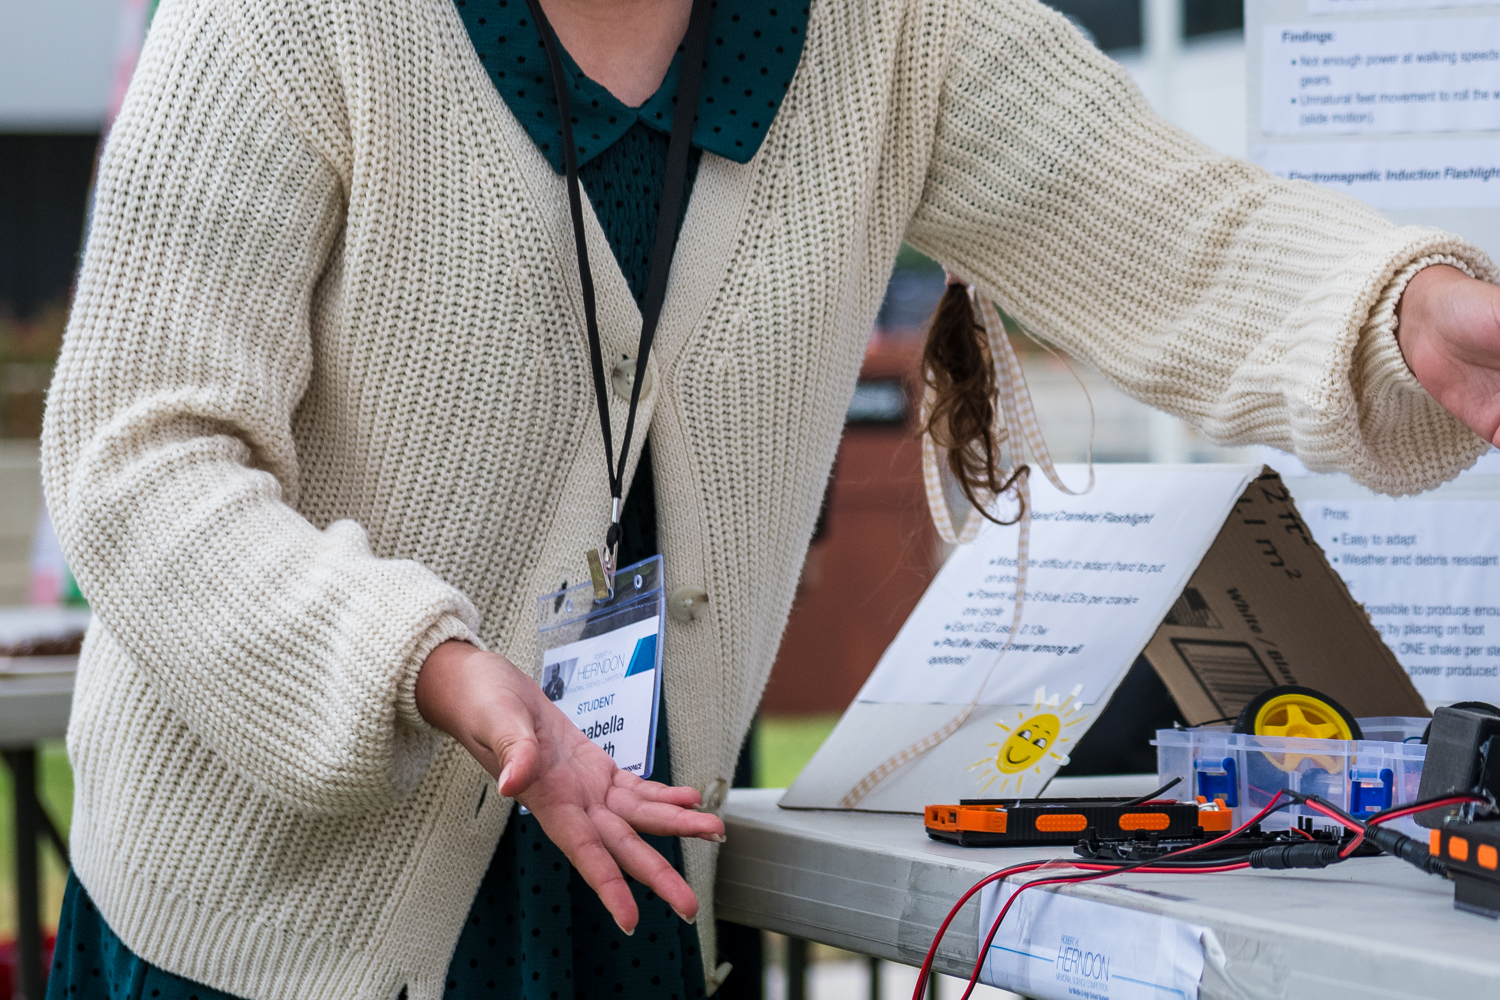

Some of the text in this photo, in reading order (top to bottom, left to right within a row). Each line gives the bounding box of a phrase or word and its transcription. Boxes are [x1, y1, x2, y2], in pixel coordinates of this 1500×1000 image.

[1342, 533, 1417, 548] Easy to adapt
[1342, 553, 1499, 567] Weather and debris resistant
[577, 693, 615, 715] STUDENT
[581, 714, 624, 740] abella
[1056, 946, 1110, 981] HERNDON
